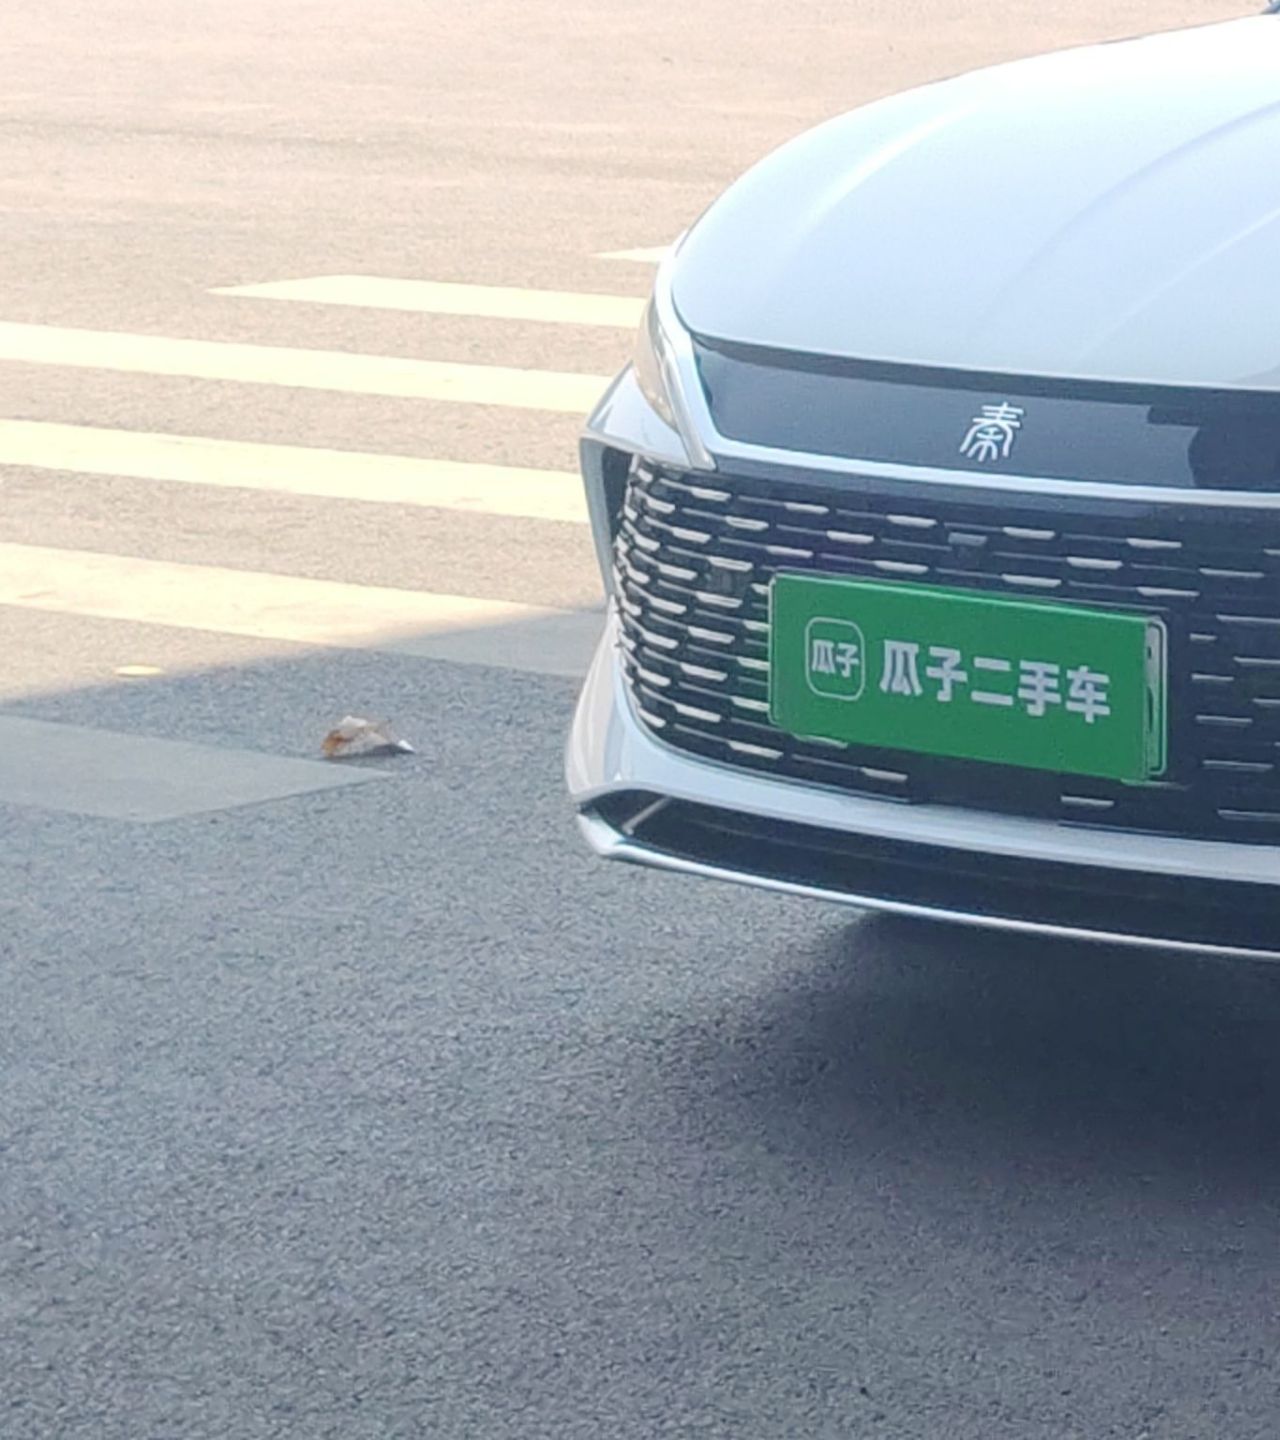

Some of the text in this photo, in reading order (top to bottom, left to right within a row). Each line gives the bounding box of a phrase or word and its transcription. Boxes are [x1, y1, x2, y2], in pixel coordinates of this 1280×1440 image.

[960, 401, 1024, 462] 秦
[811, 638, 860, 678] 瓜子
[879, 638, 1111, 724] 瓜子二手车
